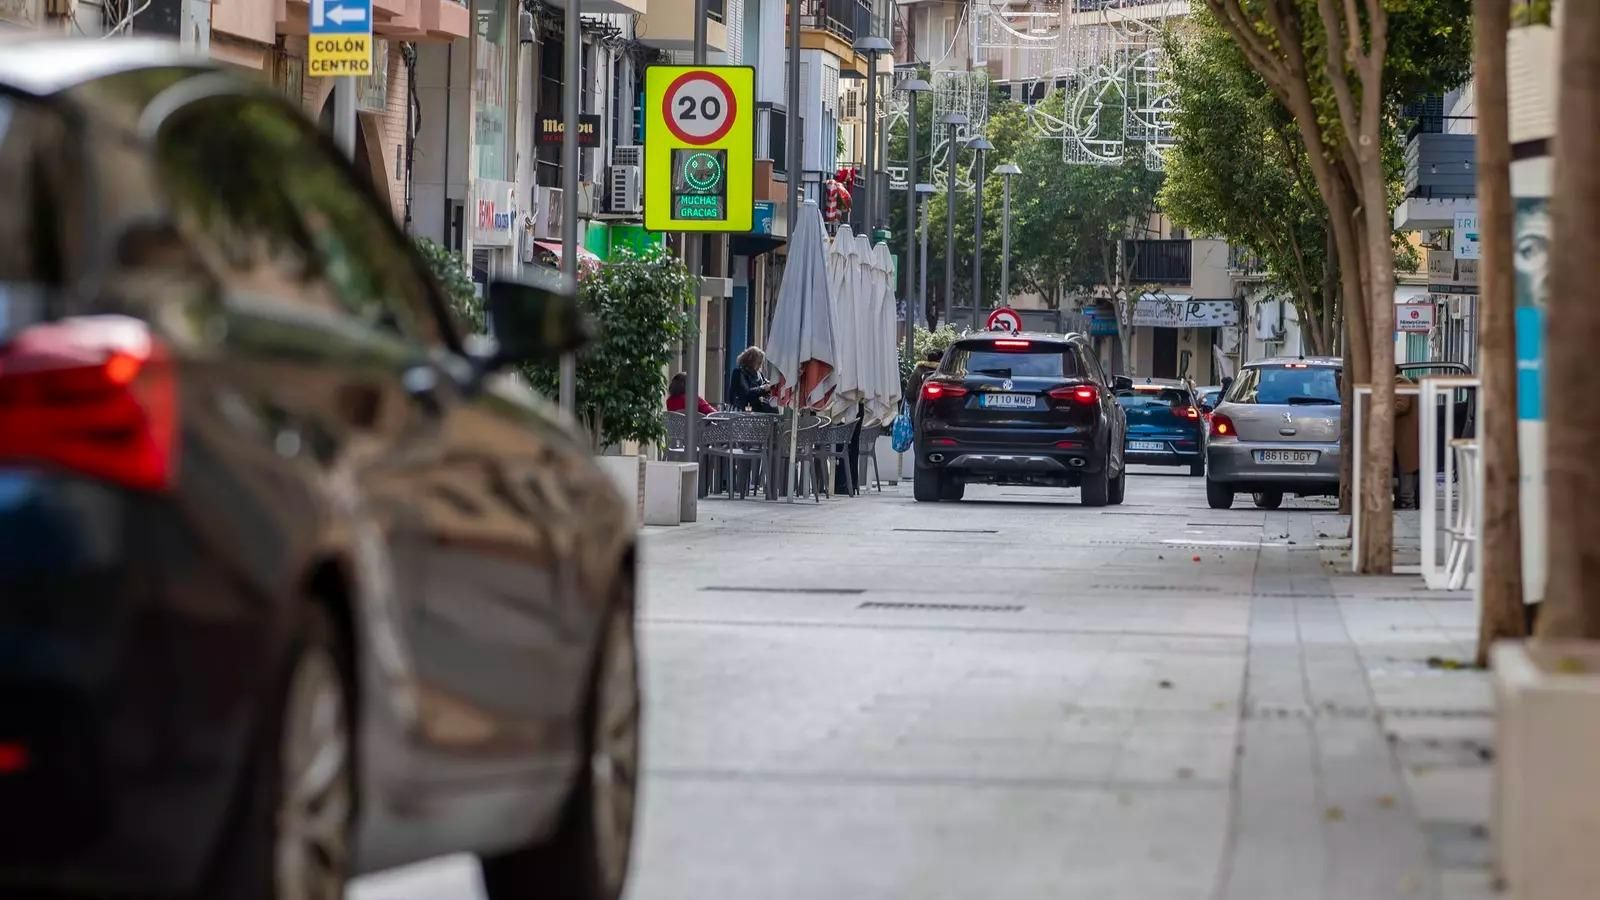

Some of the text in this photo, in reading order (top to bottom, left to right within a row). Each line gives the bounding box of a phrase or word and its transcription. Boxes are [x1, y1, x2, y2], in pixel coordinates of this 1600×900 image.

[315, 37, 364, 53] COLÓN
[311, 59, 369, 72] CENTRO
[678, 95, 721, 120] 20
[680, 195, 717, 205] MUCHAS
[680, 208, 717, 218] GRACIAS
[988, 395, 1032, 405] 7110 MMB
[1265, 451, 1312, 461] 8616 DGY
